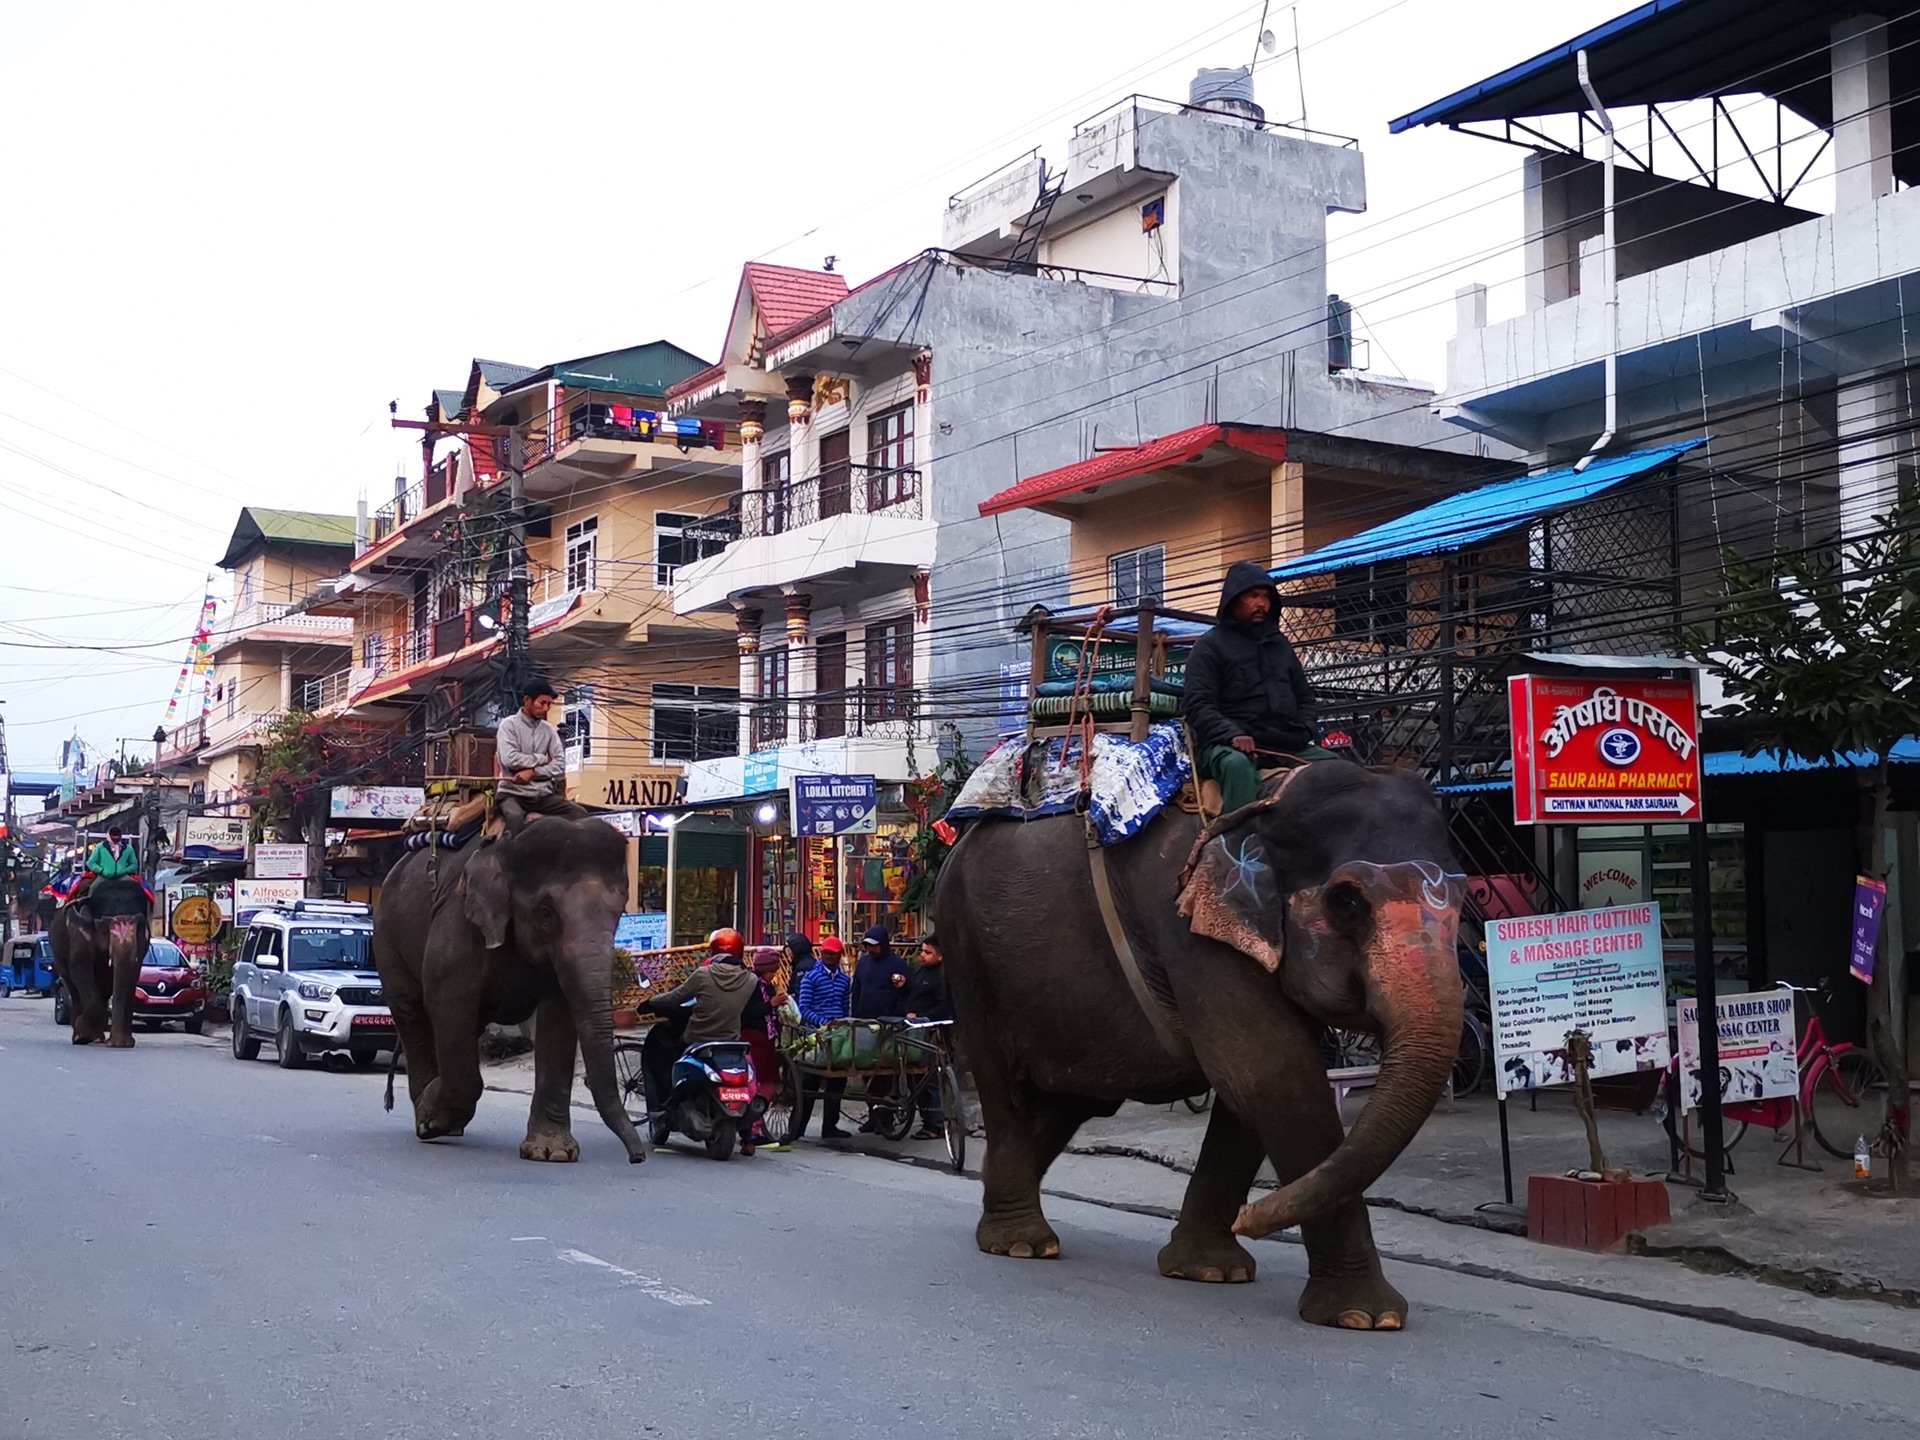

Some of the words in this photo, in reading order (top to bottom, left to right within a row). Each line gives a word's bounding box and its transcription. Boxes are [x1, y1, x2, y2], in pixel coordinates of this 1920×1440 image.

[1540, 687, 1624, 758] औषधि
[1626, 698, 1696, 760] पसल
[1550, 772, 1616, 788] SAURAHA
[1619, 772, 1693, 788] PHARMACY
[806, 786, 830, 798] LOKAL
[832, 784, 866, 796] KITCHEN
[1552, 799, 1586, 810] CHITWAN
[1588, 799, 1624, 810] NATIONAL
[1626, 799, 1644, 809] PARK
[1645, 798, 1678, 809] SAURAHA
[188, 830, 242, 842] Suryodaya
[1583, 868, 1638, 891] WEL-COME
[253, 886, 298, 897] Alfresco
[1498, 918, 1553, 941] SURESH
[1556, 914, 1588, 934] HAIR
[1593, 906, 1651, 930] CUTTING
[1510, 949, 1520, 964] &
[1524, 938, 1589, 962] MASSAGE
[1592, 932, 1642, 954] CENTER
[1572, 978, 1600, 987] Ayurvedic
[1627, 972, 1639, 980] (Full
[1640, 970, 1657, 978] Body)
[1510, 986, 1538, 994] Trimming
[1572, 989, 1587, 997] Head
[1610, 983, 1634, 992] Shoulder
[1729, 1002, 1765, 1017] BARBER
[1767, 998, 1792, 1012] SHOP
[1547, 1014, 1573, 1022] Highlight
[1746, 1018, 1780, 1034] CENTER
[1502, 1041, 1530, 1050] Threading
